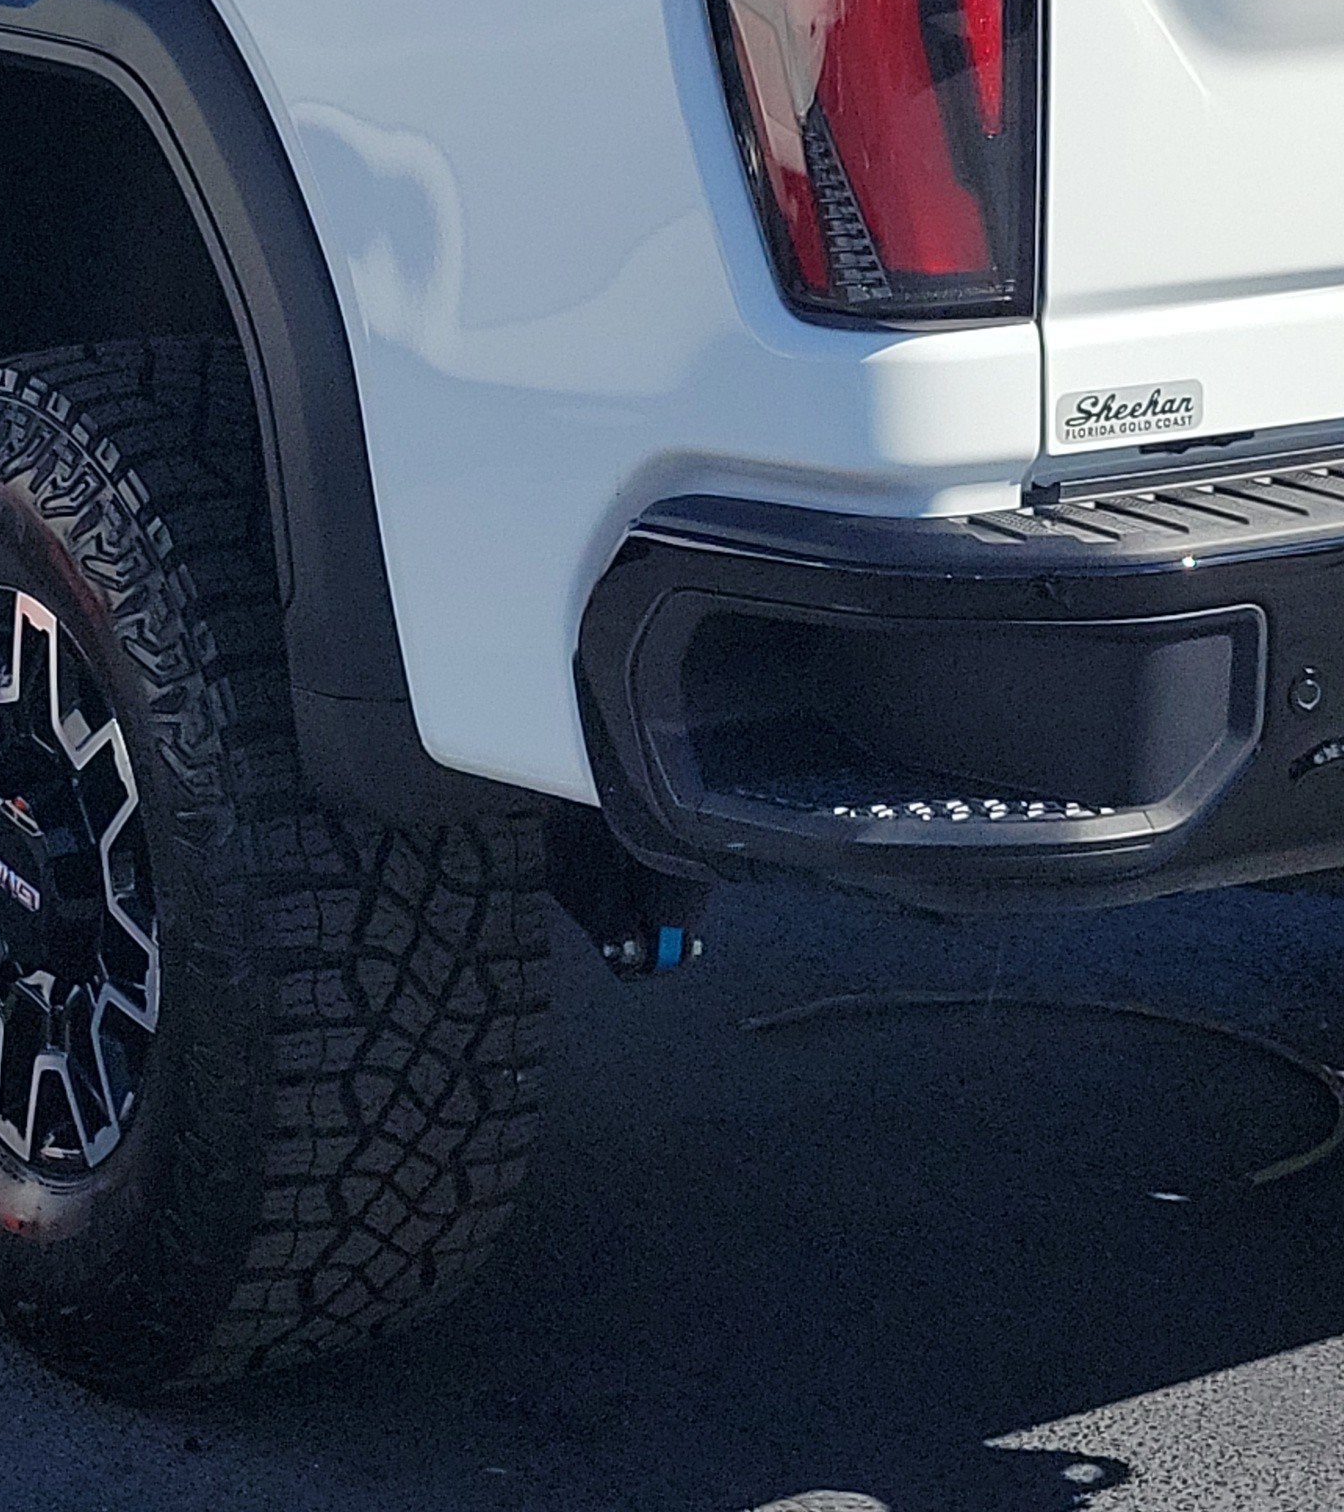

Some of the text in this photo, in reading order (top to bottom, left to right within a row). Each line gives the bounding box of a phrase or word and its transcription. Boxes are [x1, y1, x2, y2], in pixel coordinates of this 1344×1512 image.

[1064, 387, 1194, 428] Sheehan
[1064, 415, 1193, 440] FLORIDA GOLD COAST
